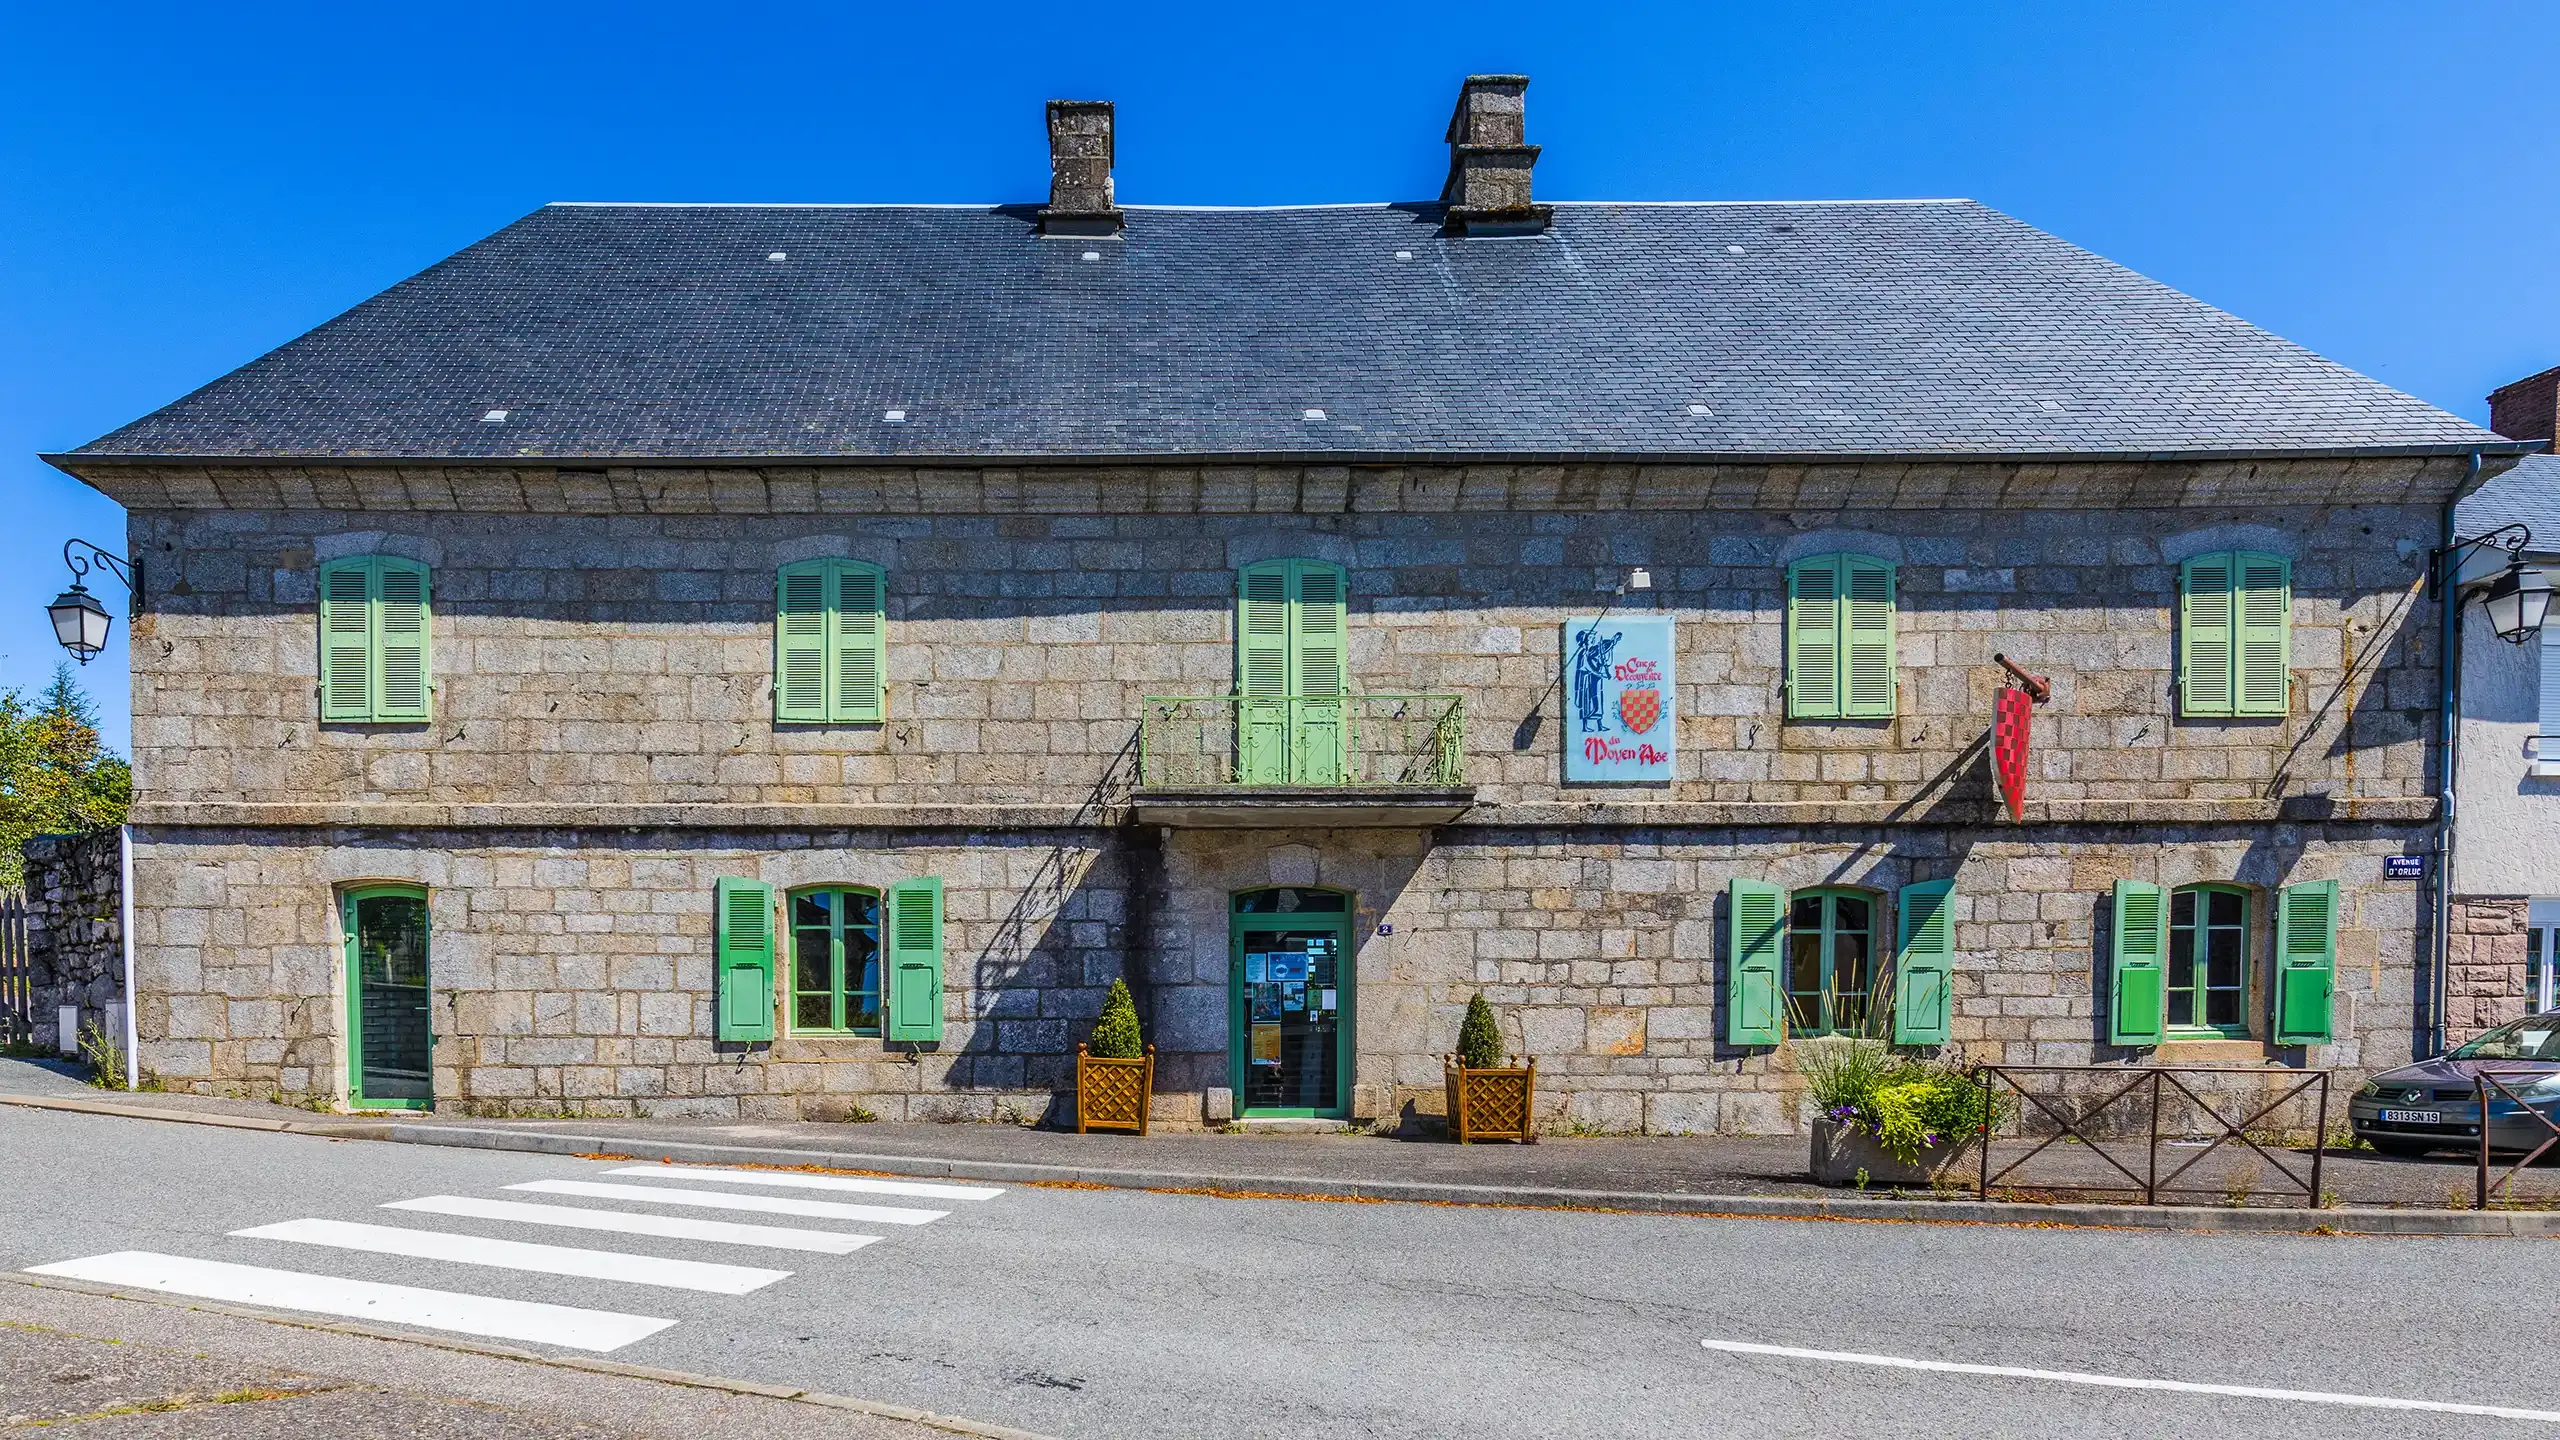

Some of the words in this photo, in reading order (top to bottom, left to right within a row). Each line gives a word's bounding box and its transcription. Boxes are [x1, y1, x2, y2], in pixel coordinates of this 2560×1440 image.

[1609, 736, 1620, 745] du
[1585, 737, 1636, 765] Moyen
[2392, 858, 2420, 866] AVENUE
[1382, 925, 1389, 933] 2
